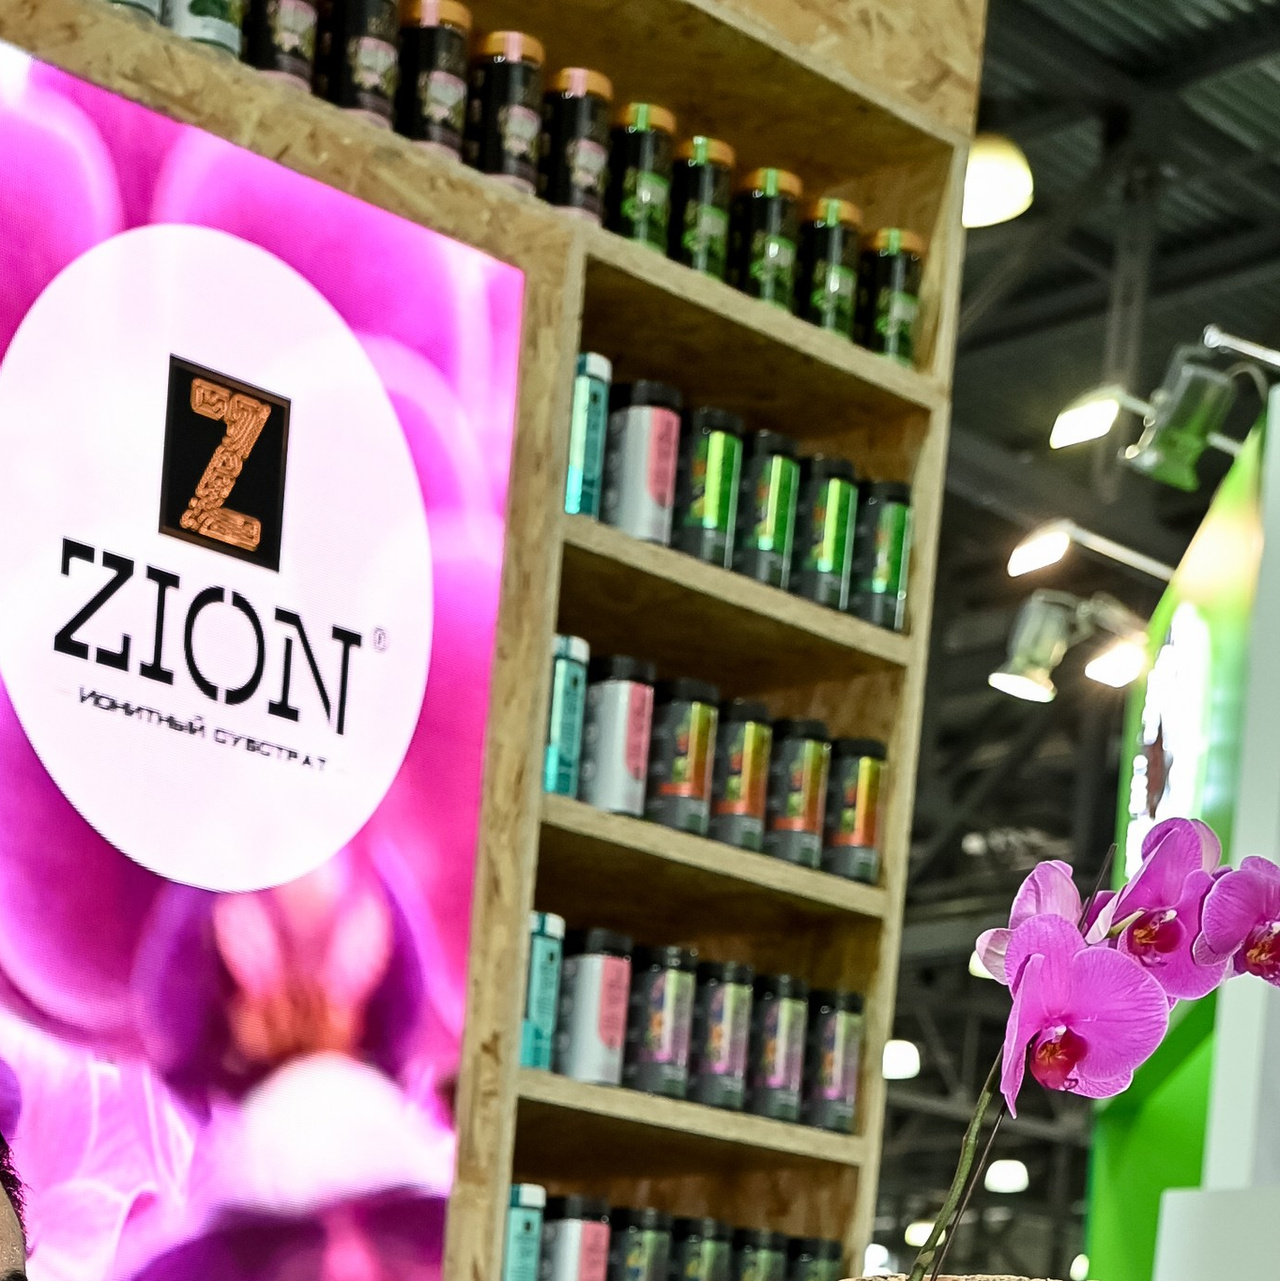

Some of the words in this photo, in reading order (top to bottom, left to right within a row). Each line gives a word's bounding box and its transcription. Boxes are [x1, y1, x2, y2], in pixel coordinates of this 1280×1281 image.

[54, 536, 362, 735] ZION
[79, 686, 205, 738] ИОНИТНЫЙ
[214, 728, 326, 771] СУБСТРАТ
